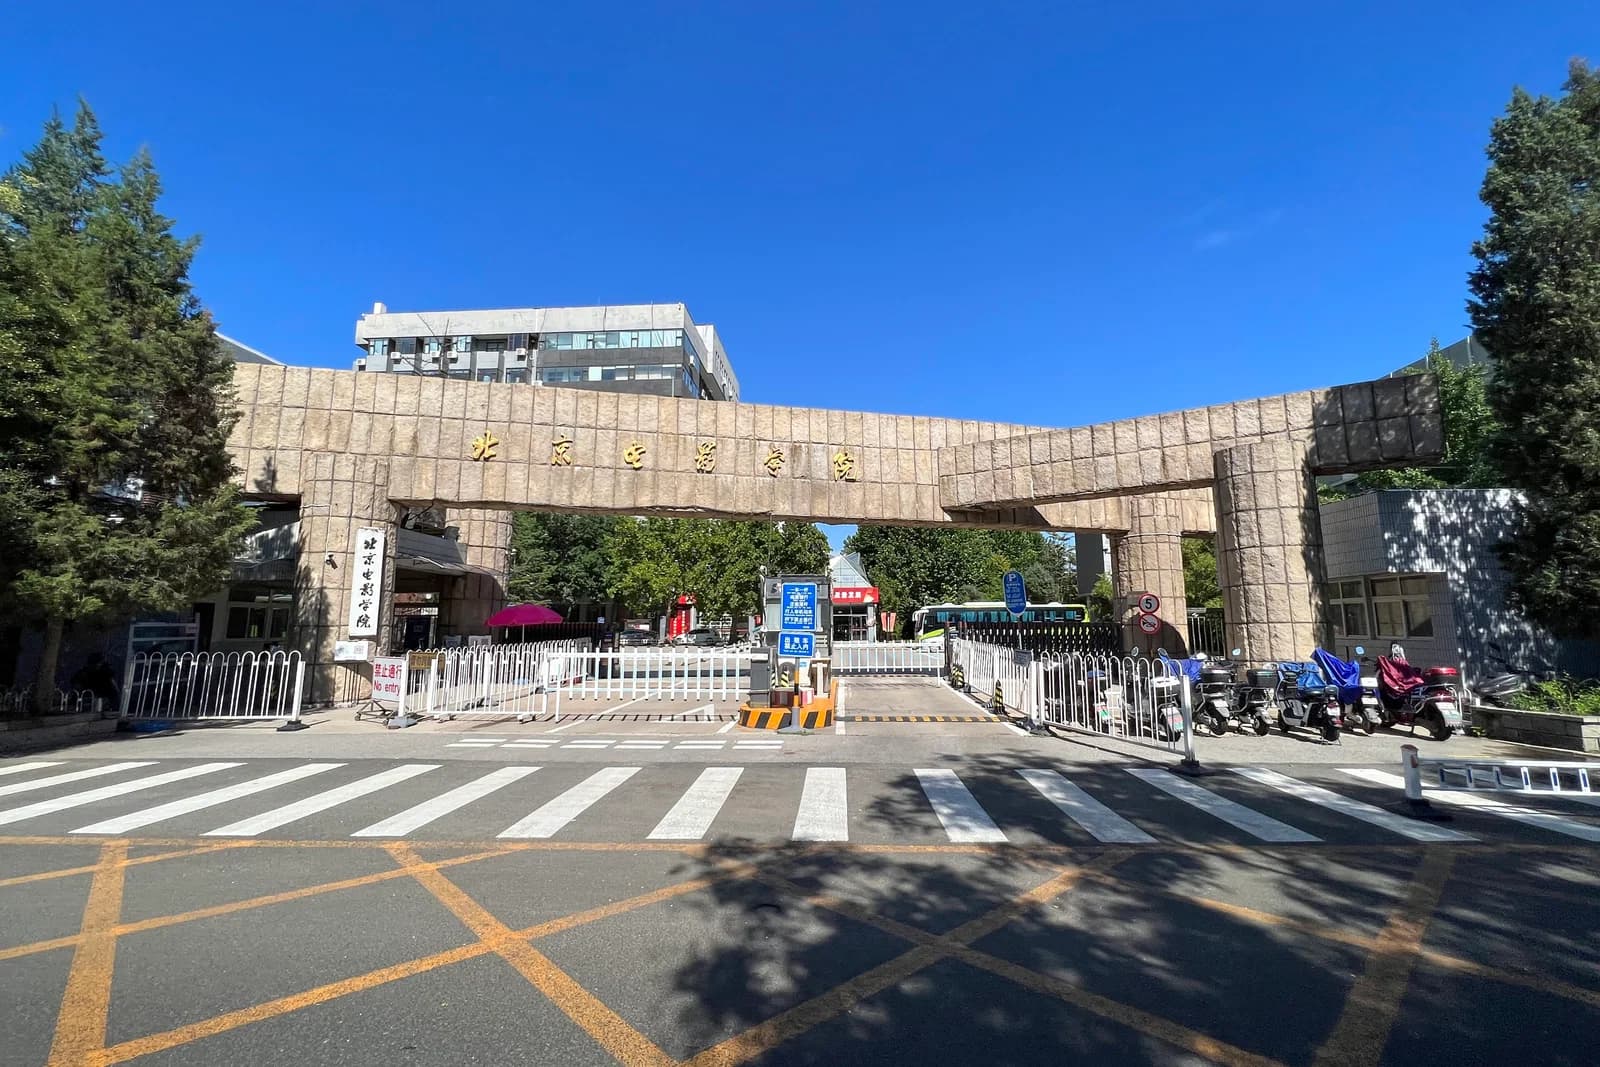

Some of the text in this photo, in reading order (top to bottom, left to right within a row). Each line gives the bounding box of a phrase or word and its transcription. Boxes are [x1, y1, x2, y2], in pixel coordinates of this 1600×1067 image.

[472, 429, 857, 482] 北京电影学院
[356, 537, 377, 628] 北京电影学院
[1008, 573, 1016, 582] P
[1145, 598, 1152, 609] 5
[374, 663, 402, 678] 禁止通行
[374, 680, 400, 697] No entry
